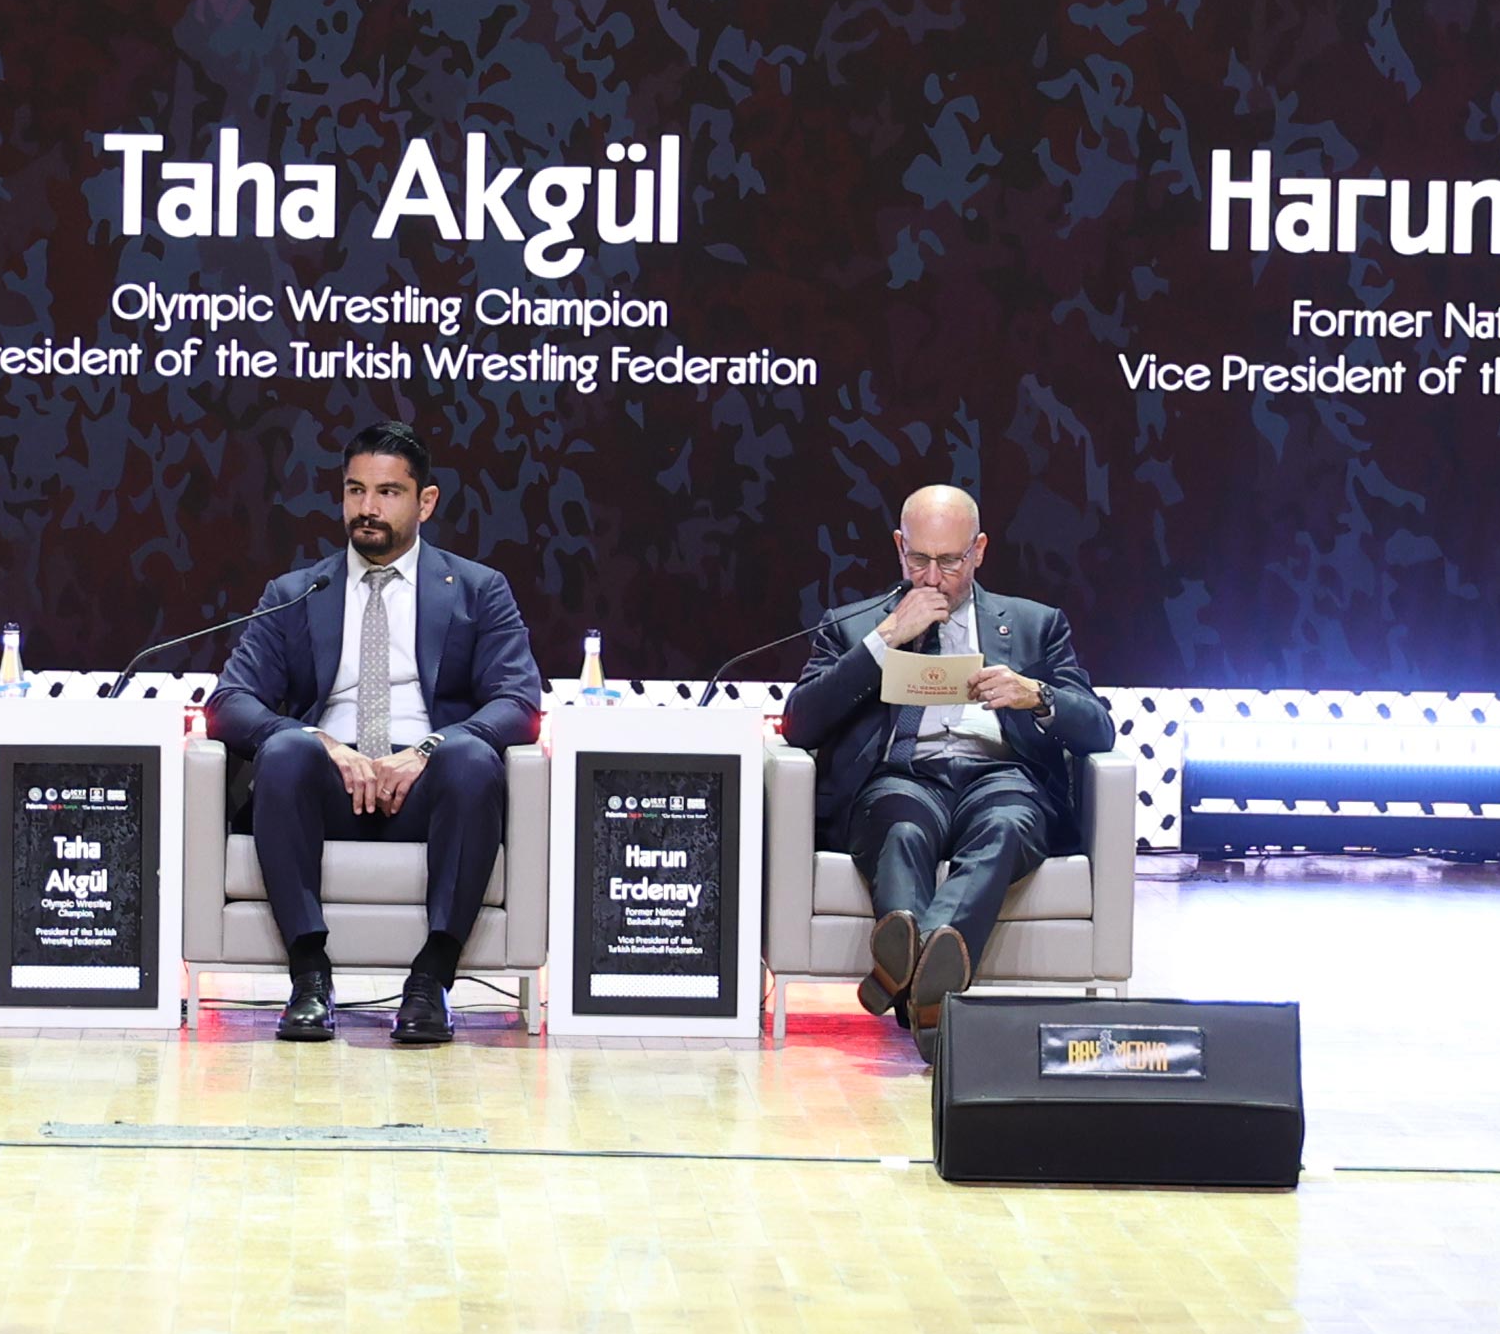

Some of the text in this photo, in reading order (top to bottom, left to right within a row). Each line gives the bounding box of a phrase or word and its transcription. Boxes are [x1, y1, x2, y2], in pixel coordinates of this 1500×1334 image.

[104, 128, 680, 278] Taha Akgül
[112, 282, 668, 337] Olympic Wrestling Champion
[1293, 300, 1433, 339] Former
[155, 338, 203, 377] of
[216, 339, 278, 378] the
[290, 341, 412, 380] Turkish
[423, 344, 599, 392] Wrestling
[612, 346, 817, 386] Federation
[1119, 354, 1211, 392] Vice
[1223, 355, 1407, 394] President
[1419, 356, 1467, 395] of
[53, 835, 101, 859] Taha
[626, 844, 687, 868] Harun
[45, 868, 108, 899] Akgül
[610, 876, 702, 908] Erdenay
[41, 899, 112, 911] Olympic Wrestling
[1068, 1040, 1101, 1067] BAY
